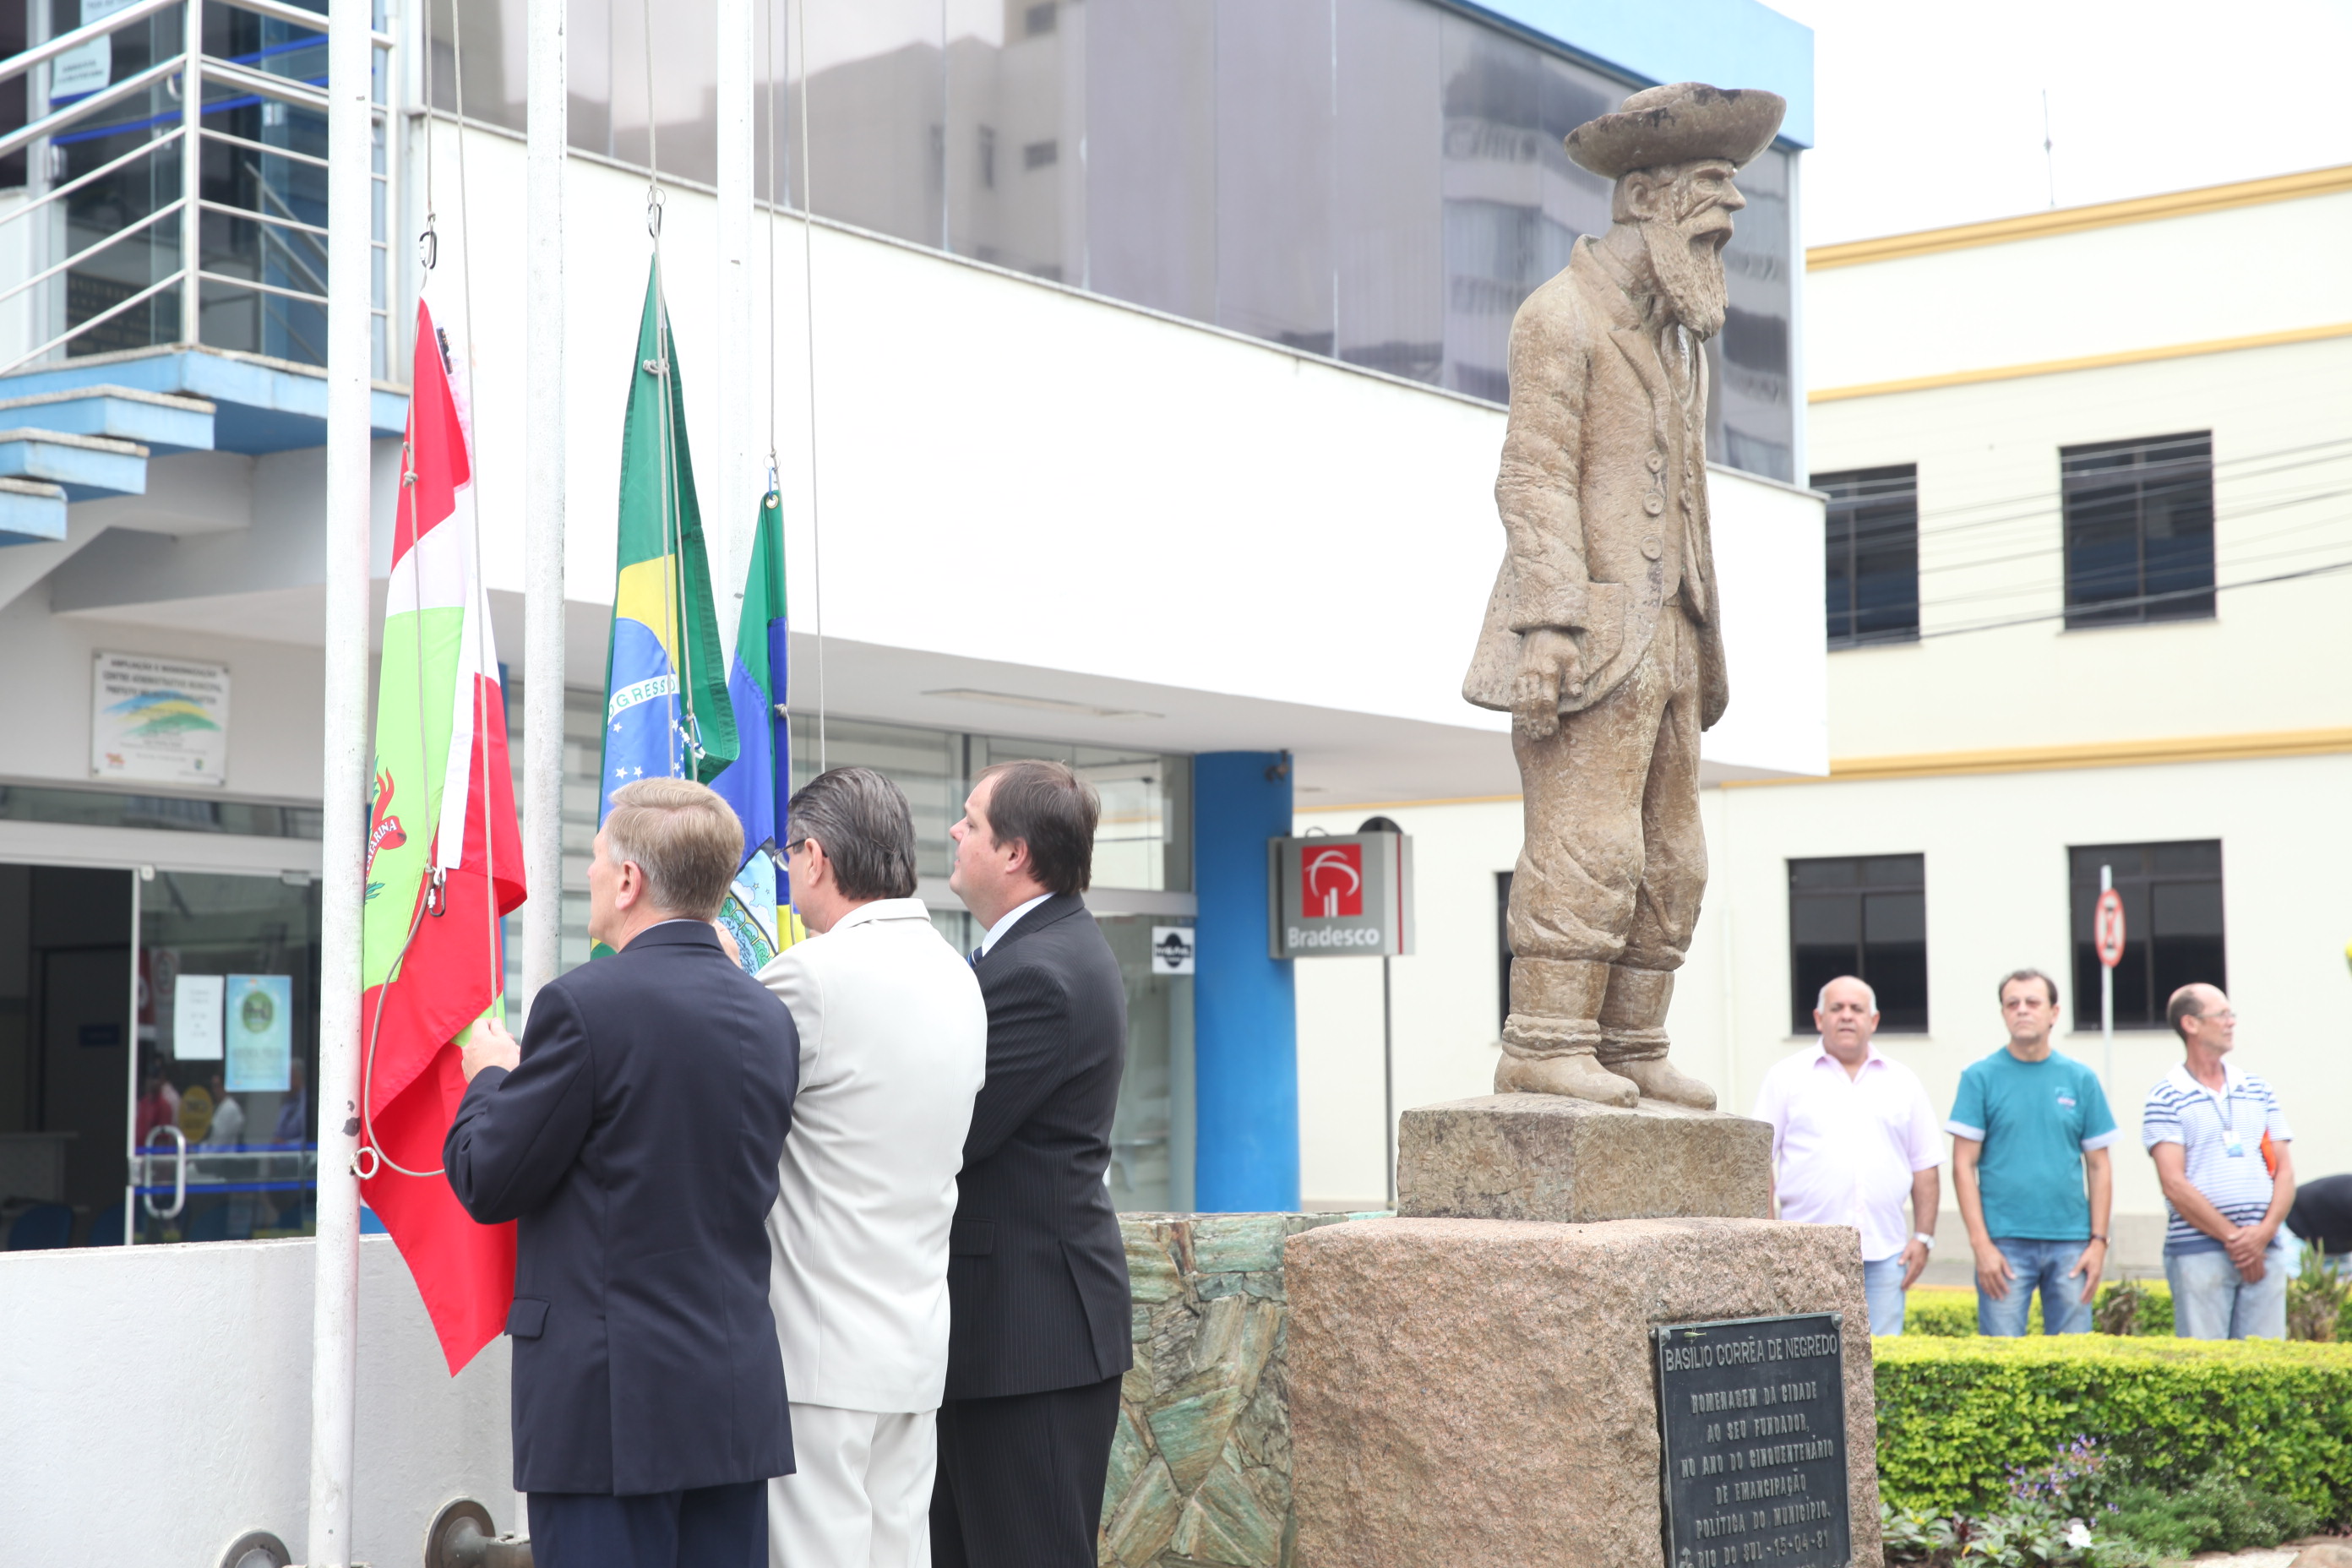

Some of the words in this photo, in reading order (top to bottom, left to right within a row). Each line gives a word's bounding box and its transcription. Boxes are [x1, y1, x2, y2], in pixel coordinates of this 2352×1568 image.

[1288, 925, 1380, 948] Bradesco
[1716, 1336, 1766, 1367] CORRÊA
[1767, 1338, 1783, 1362] DE
[1784, 1334, 1838, 1358] NEGREDO
[1690, 1388, 1757, 1414] HOMENAGEM
[1764, 1386, 1777, 1406] DA
[1782, 1381, 1817, 1403] CIDADE
[1707, 1424, 1721, 1444] AO
[1727, 1420, 1746, 1440] SEU
[1754, 1413, 1810, 1438] FUNDADOR,
[1681, 1457, 1696, 1478] NO
[1702, 1454, 1724, 1476] ANO
[1730, 1451, 1744, 1472] DO
[1749, 1435, 1834, 1468] CINQUENTENÁRIO
[1716, 1485, 1729, 1505] DE
[1735, 1467, 1806, 1502] EMANCIPAÇÃO
[1696, 1511, 1745, 1540] POLÍTICA
[1752, 1510, 1766, 1531] DO
[1773, 1496, 1832, 1527] MUNICÍPIO.
[1697, 1549, 1717, 1568] RIO
[1723, 1546, 1737, 1565] DO
[1743, 1541, 1763, 1562] SUL
